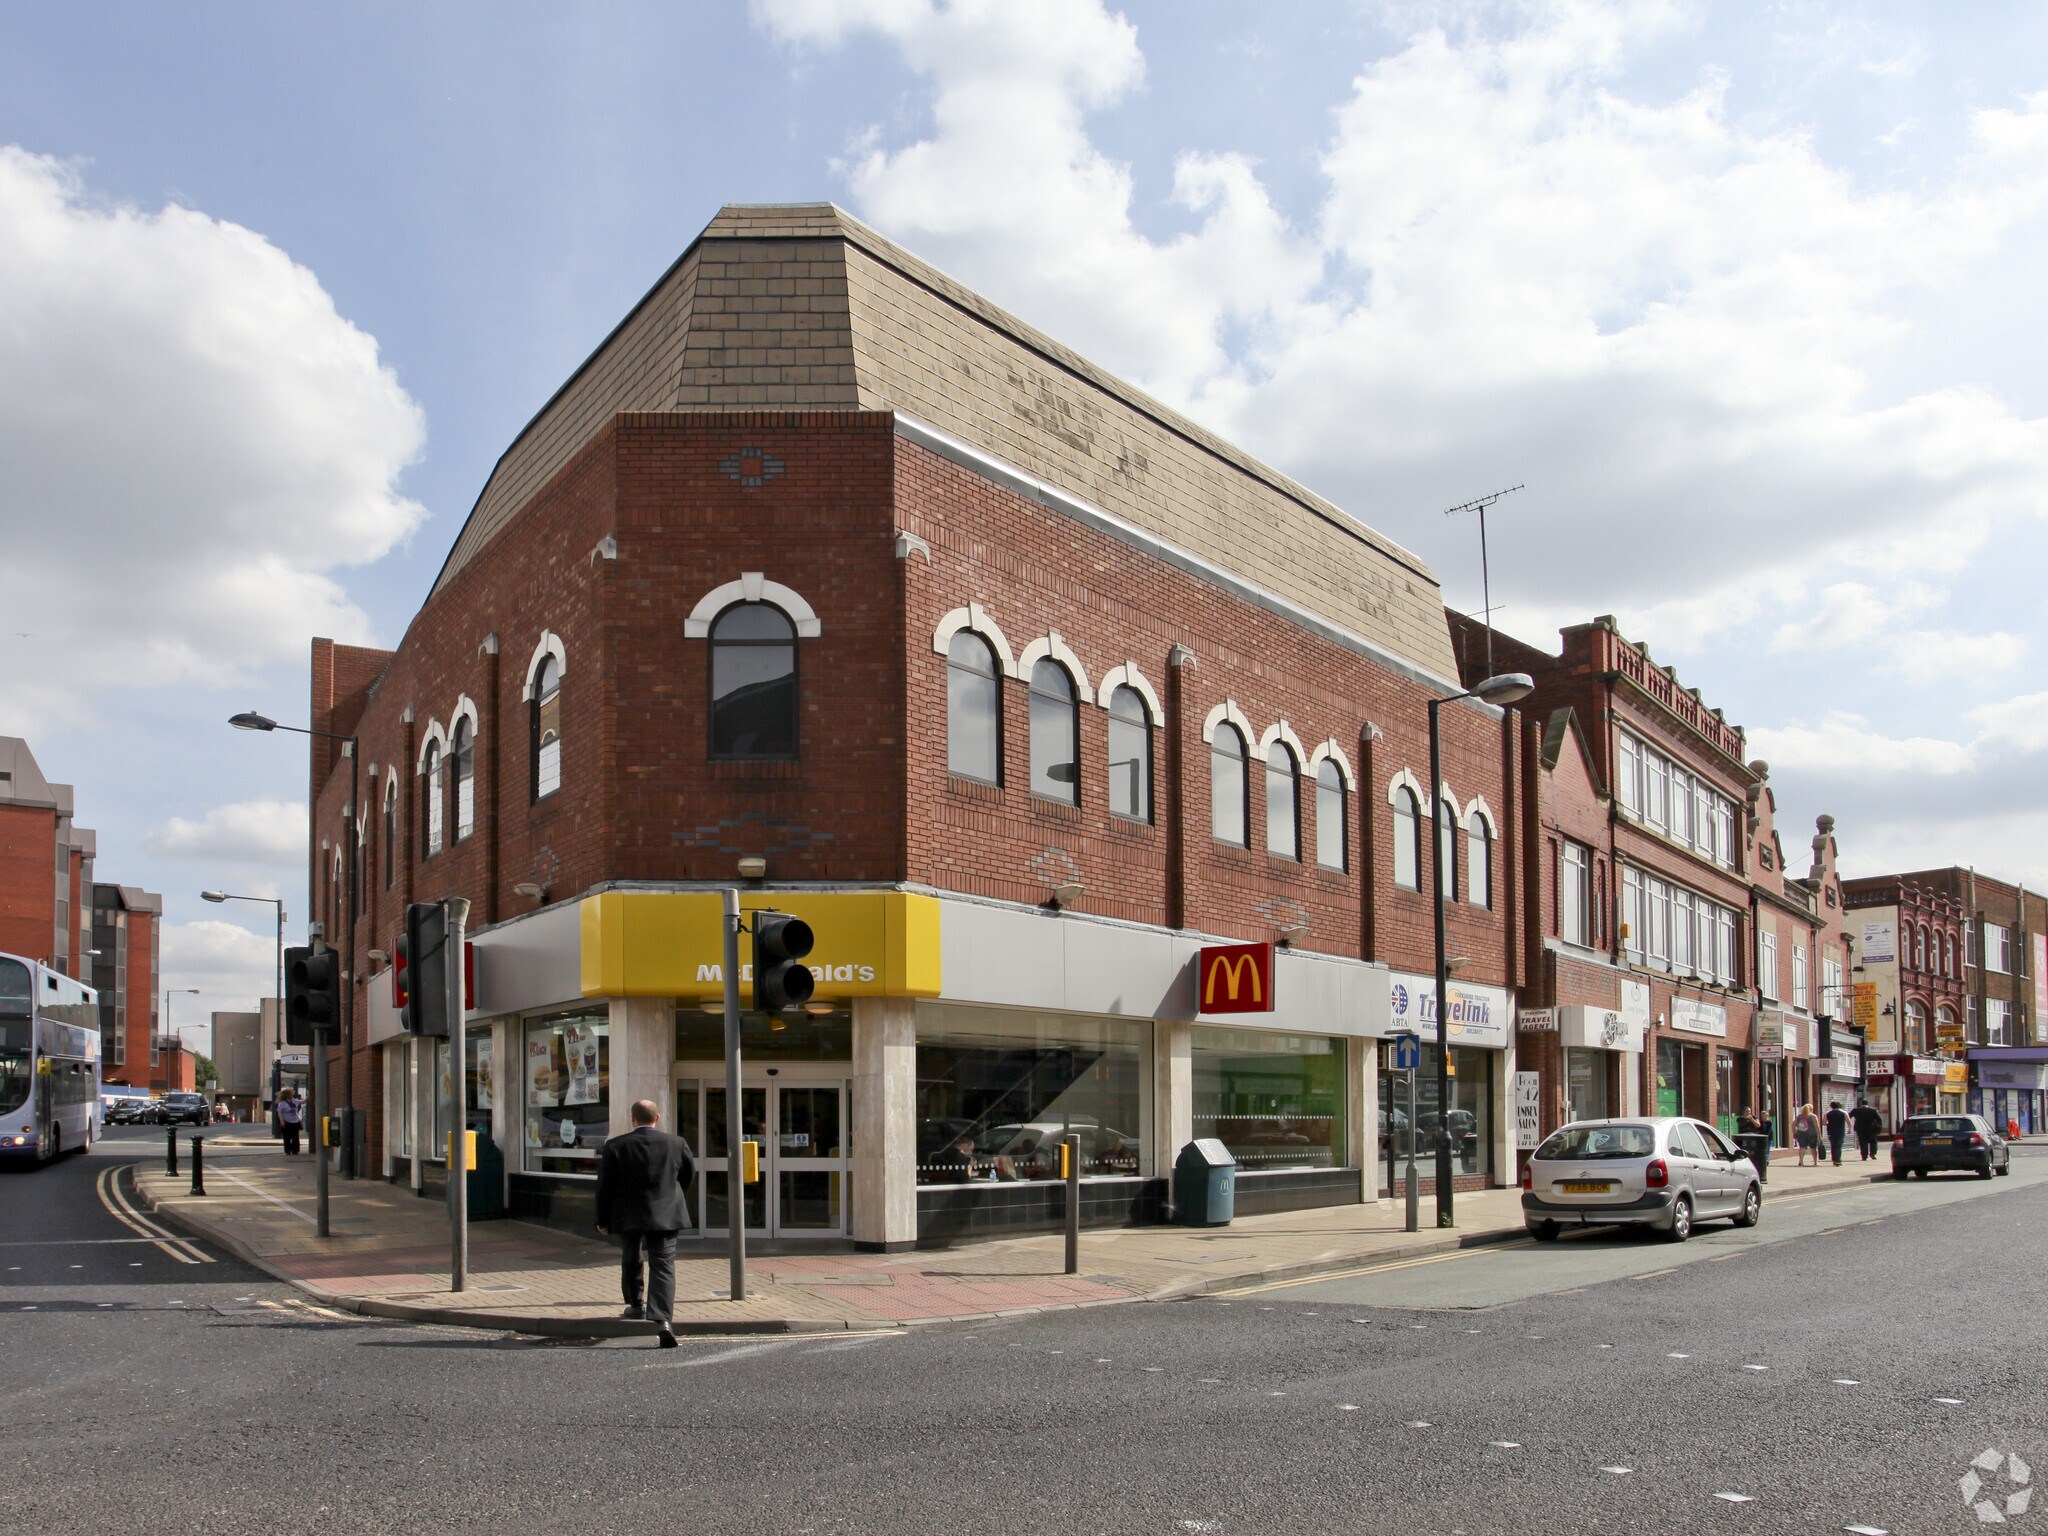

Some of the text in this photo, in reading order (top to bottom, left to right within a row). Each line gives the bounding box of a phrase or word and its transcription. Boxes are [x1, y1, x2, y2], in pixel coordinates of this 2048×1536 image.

[1419, 993, 1491, 1024] Trvelink
[1391, 1017, 1409, 1028] ABTA
[1521, 1016, 1551, 1024] TRAVEL
[1522, 1023, 1550, 1031] AGENT
[1517, 1105, 1538, 1117] UNISEX
[1518, 1118, 1537, 1130] SALON
